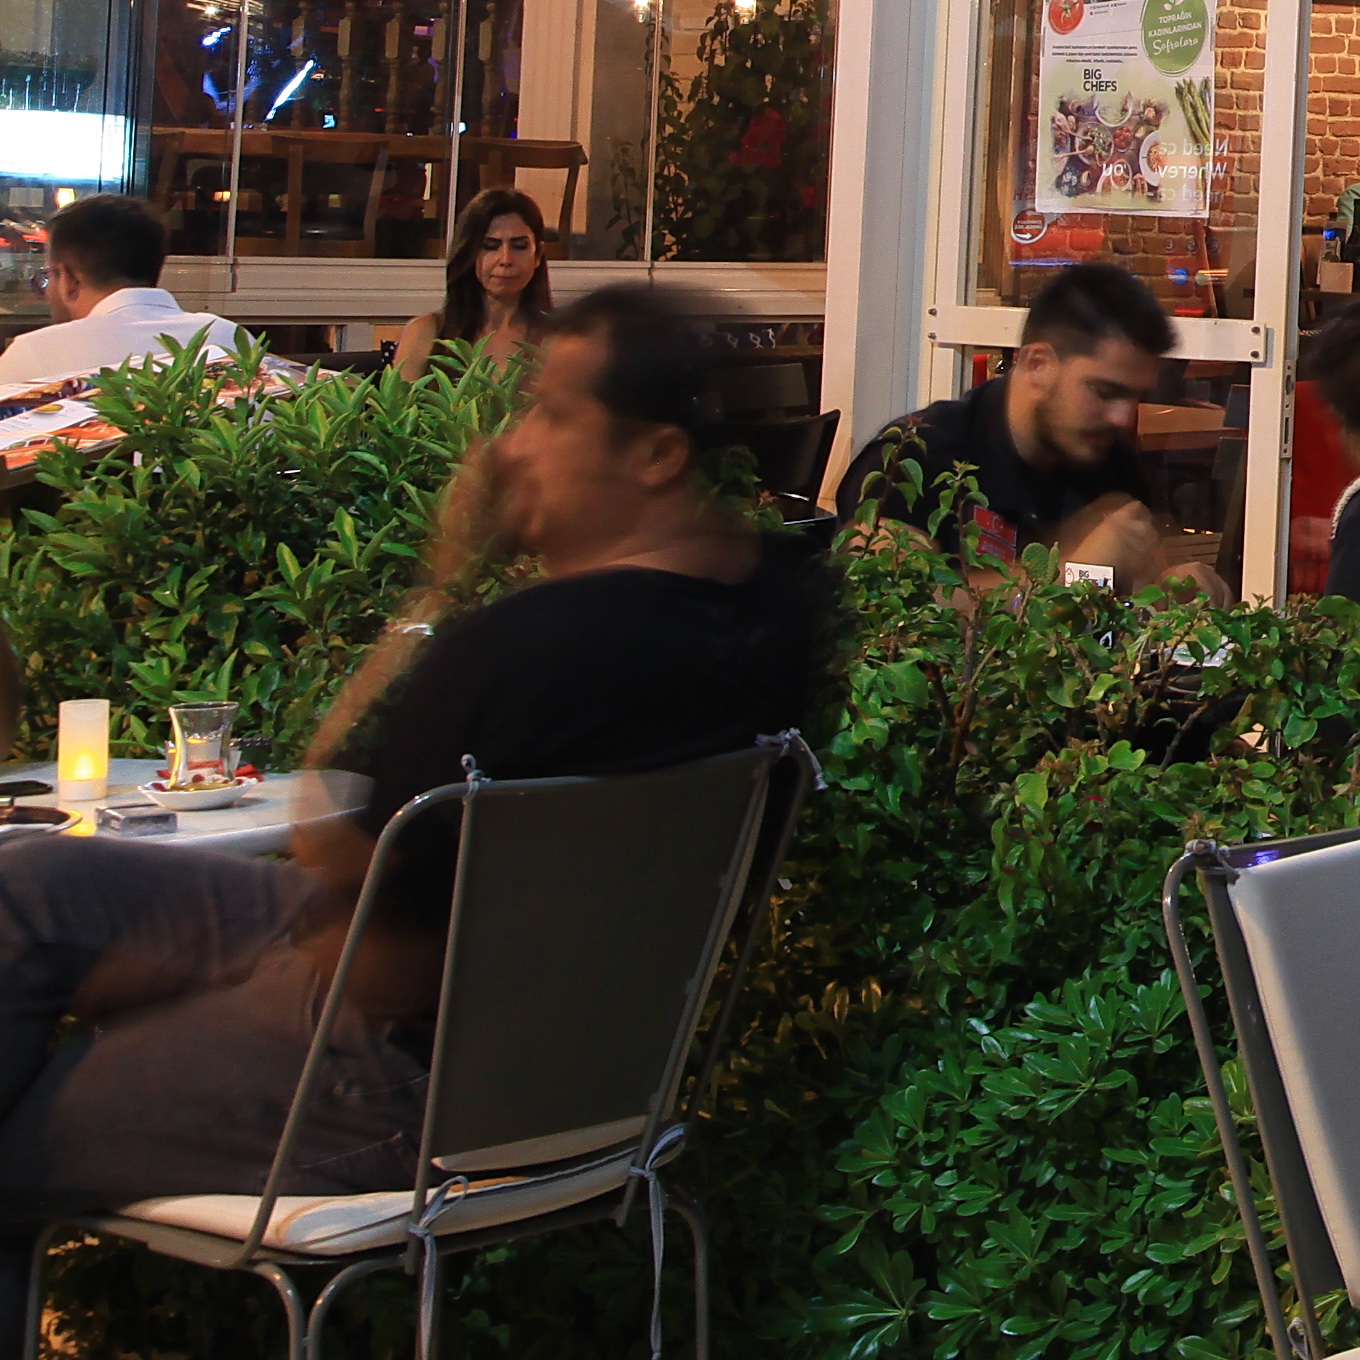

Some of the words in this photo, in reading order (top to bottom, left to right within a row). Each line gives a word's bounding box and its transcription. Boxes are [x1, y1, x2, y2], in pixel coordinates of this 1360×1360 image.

[1083, 68, 1102, 80] BIG
[1083, 80, 1118, 92] CHEFS
[1078, 569, 1089, 578] BIG
